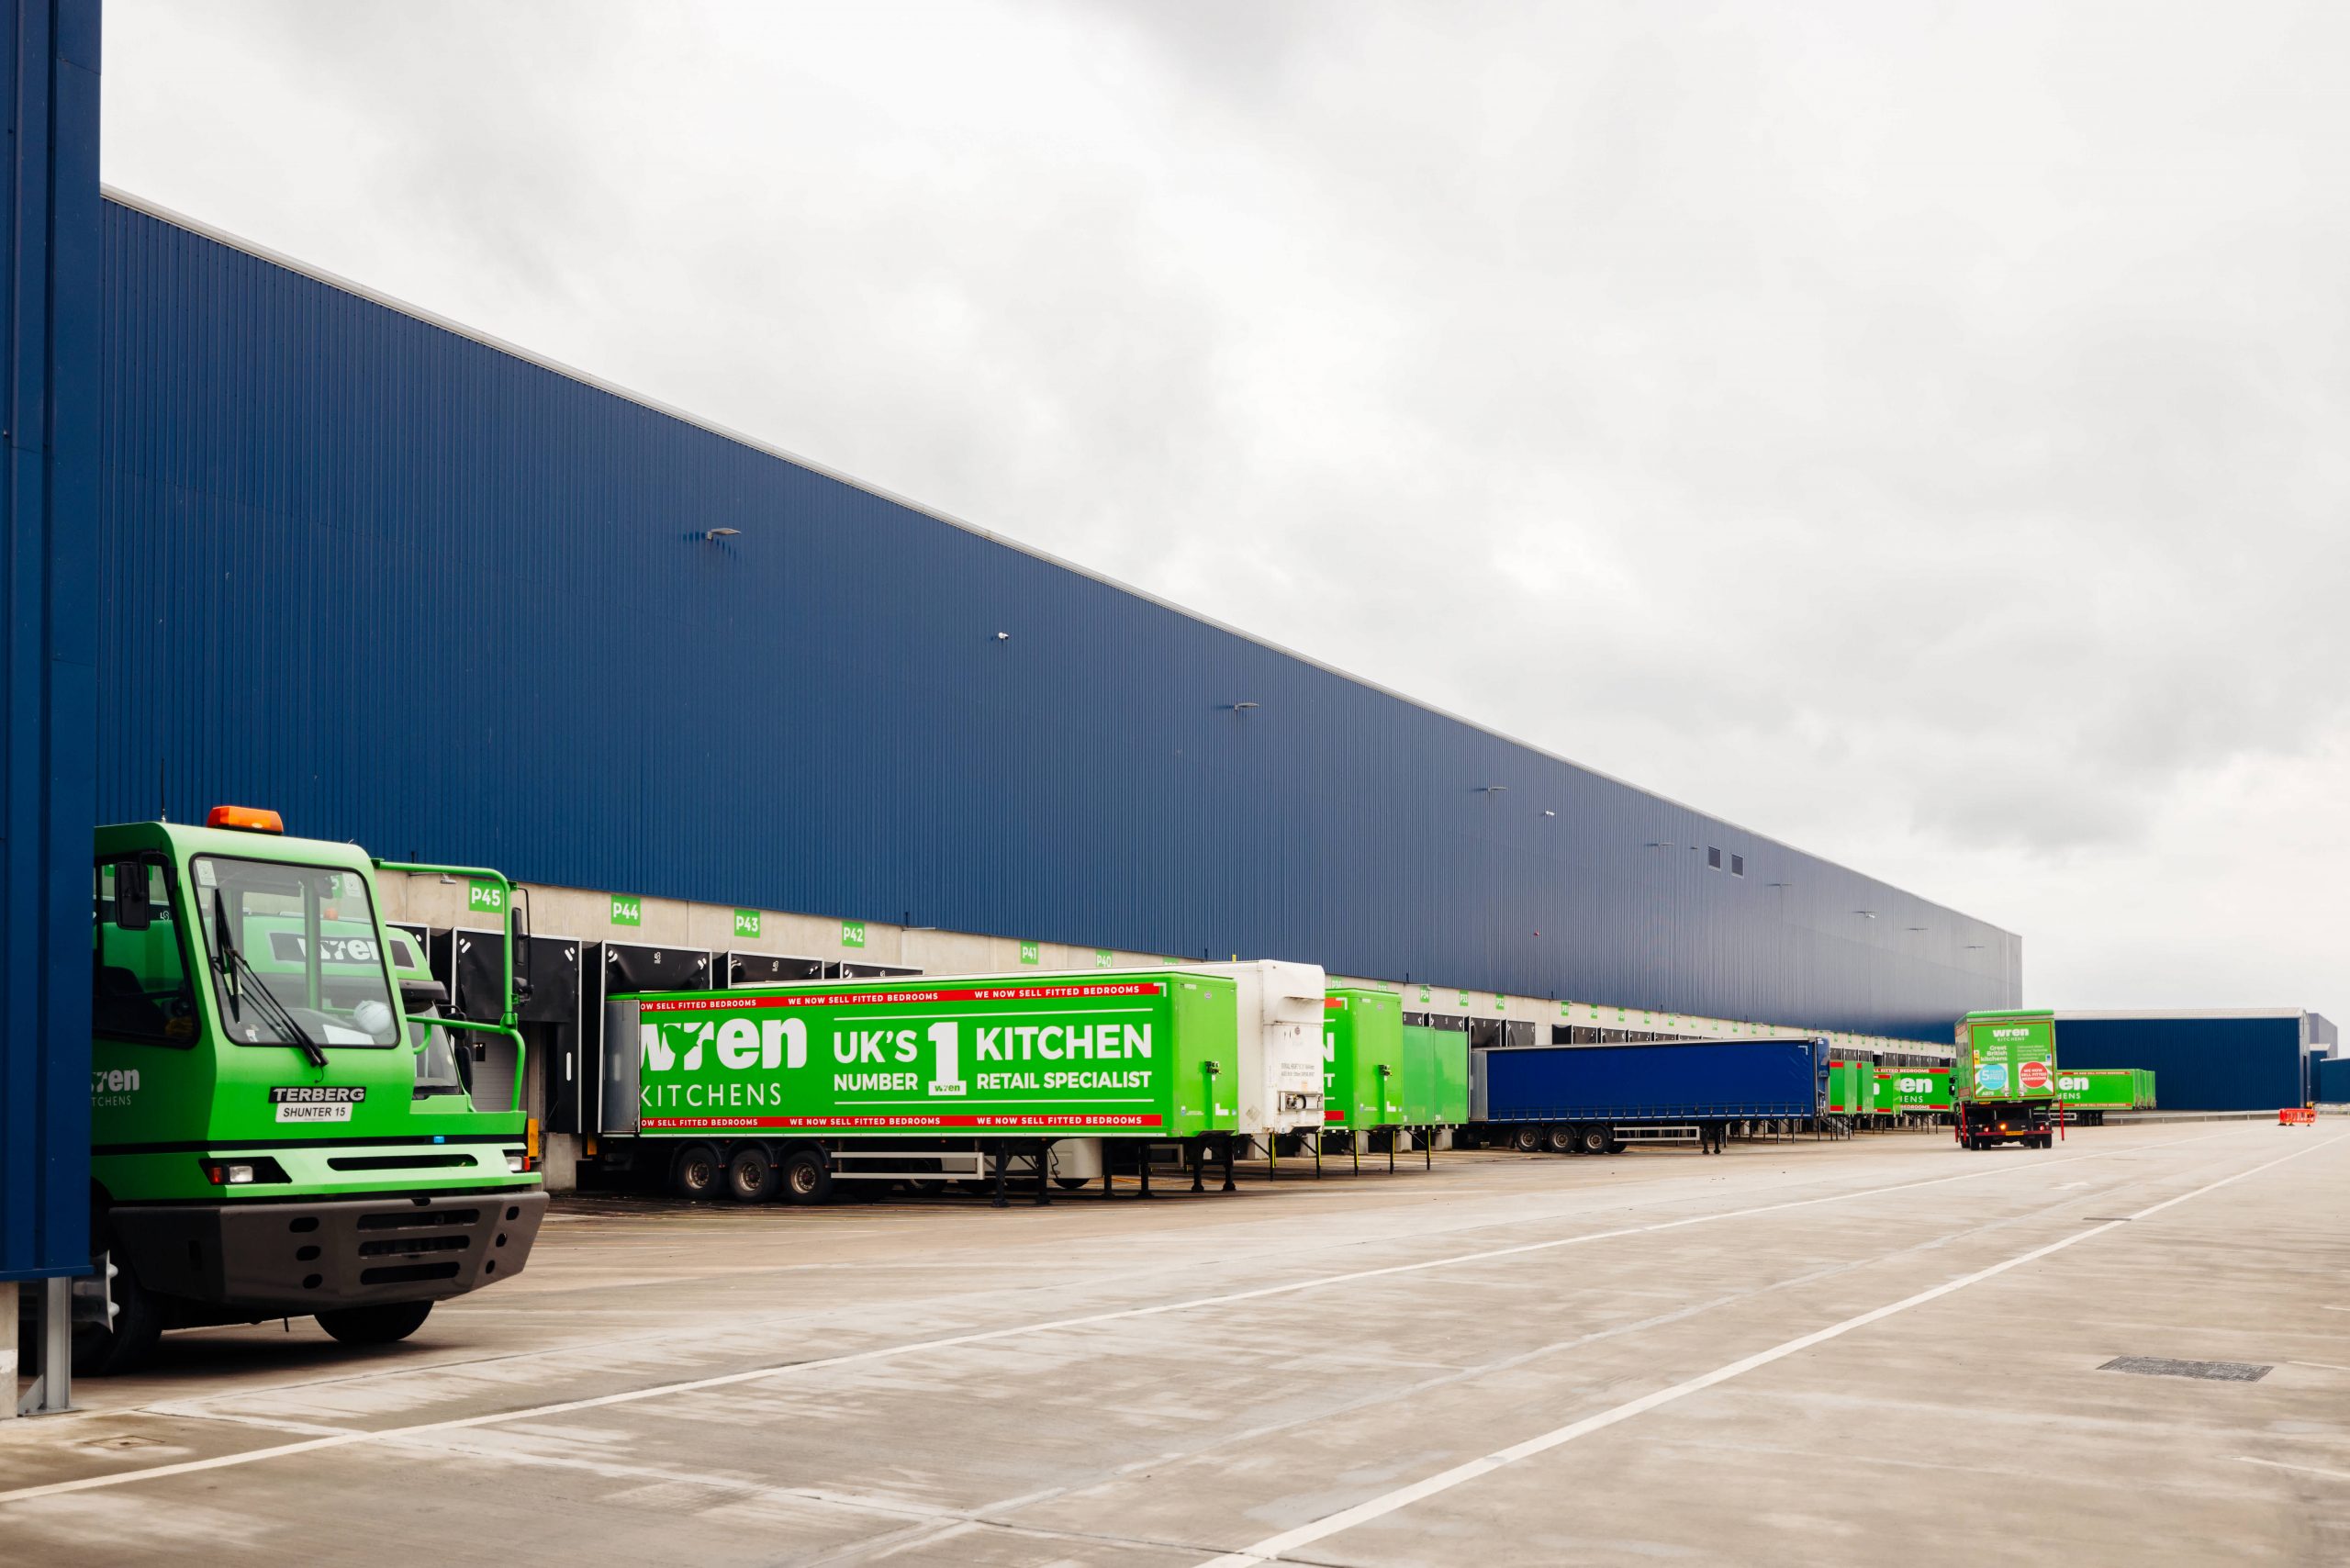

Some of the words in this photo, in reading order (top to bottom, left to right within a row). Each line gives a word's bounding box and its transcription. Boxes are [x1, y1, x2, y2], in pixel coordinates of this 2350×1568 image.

[471, 887, 501, 907] P45
[613, 902, 638, 921] P44
[736, 915, 759, 933] P43
[843, 927, 864, 943] P42
[1022, 946, 1037, 960] P41
[1096, 955, 1112, 968] P40
[887, 992, 938, 1002] BEDROOMS
[992, 990, 1015, 998] NOW
[1019, 989, 1042, 997] SELL
[1046, 988, 1080, 996] FITTED
[1083, 985, 1139, 994] BEDROOMS
[656, 1002, 676, 1010] SELL
[678, 1001, 707, 1009] FITTED
[710, 999, 756, 1008] BEDROOMS
[1992, 1028, 2030, 1037] wren
[641, 1017, 808, 1071] wren
[834, 1029, 918, 1064] UK'S
[976, 1024, 1152, 1061] KITCHEN
[927, 1022, 968, 1096] 1
[91, 1069, 140, 1093] ren
[834, 1072, 919, 1092] NUMBER
[934, 1083, 961, 1092] wren
[977, 1072, 1040, 1090] RETAIL
[1043, 1070, 1152, 1089] SPECIALIST
[1900, 1077, 1933, 1093] en
[2058, 1076, 2090, 1092] en
[91, 1094, 132, 1107] TCHENS
[273, 1088, 364, 1102] TERBERG
[283, 1107, 332, 1117] SHUNTER
[335, 1107, 346, 1116] 15
